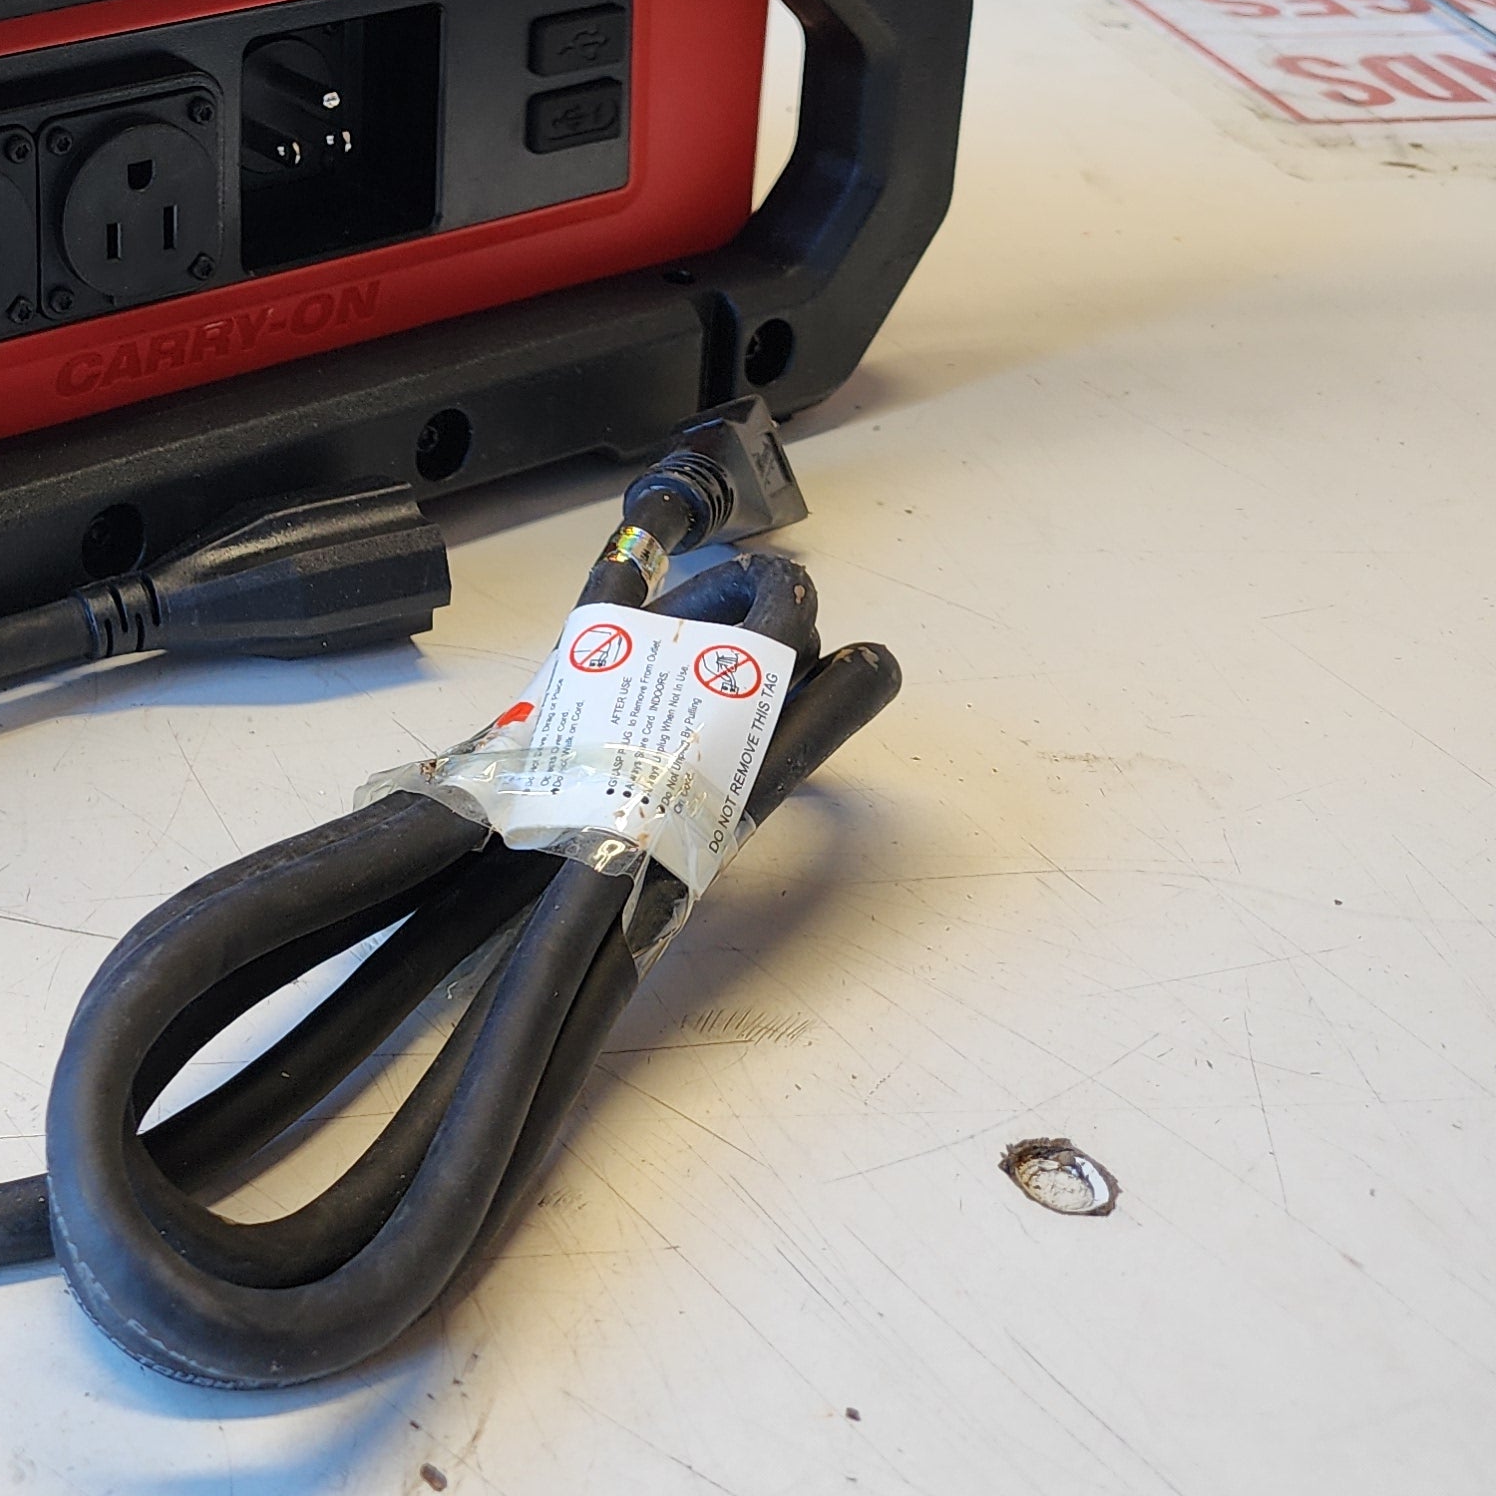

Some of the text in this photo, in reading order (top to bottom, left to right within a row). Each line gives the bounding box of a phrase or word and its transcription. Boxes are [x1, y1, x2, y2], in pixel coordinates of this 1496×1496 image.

[56, 279, 381, 398] CARRY-ON
[631, 686, 648, 718] Remove
[640, 662, 654, 684] From
[673, 680, 682, 692] In
[610, 676, 633, 725] AFTER USE
[669, 691, 680, 710] Not
[684, 696, 702, 727] Pulling
[642, 715, 656, 736] Cord
[661, 707, 676, 732] When
[681, 724, 693, 740] By
[709, 672, 779, 853] DO NOT REMOVE THIS TAG
[666, 771, 680, 789] Not
[661, 787, 672, 806] Do
